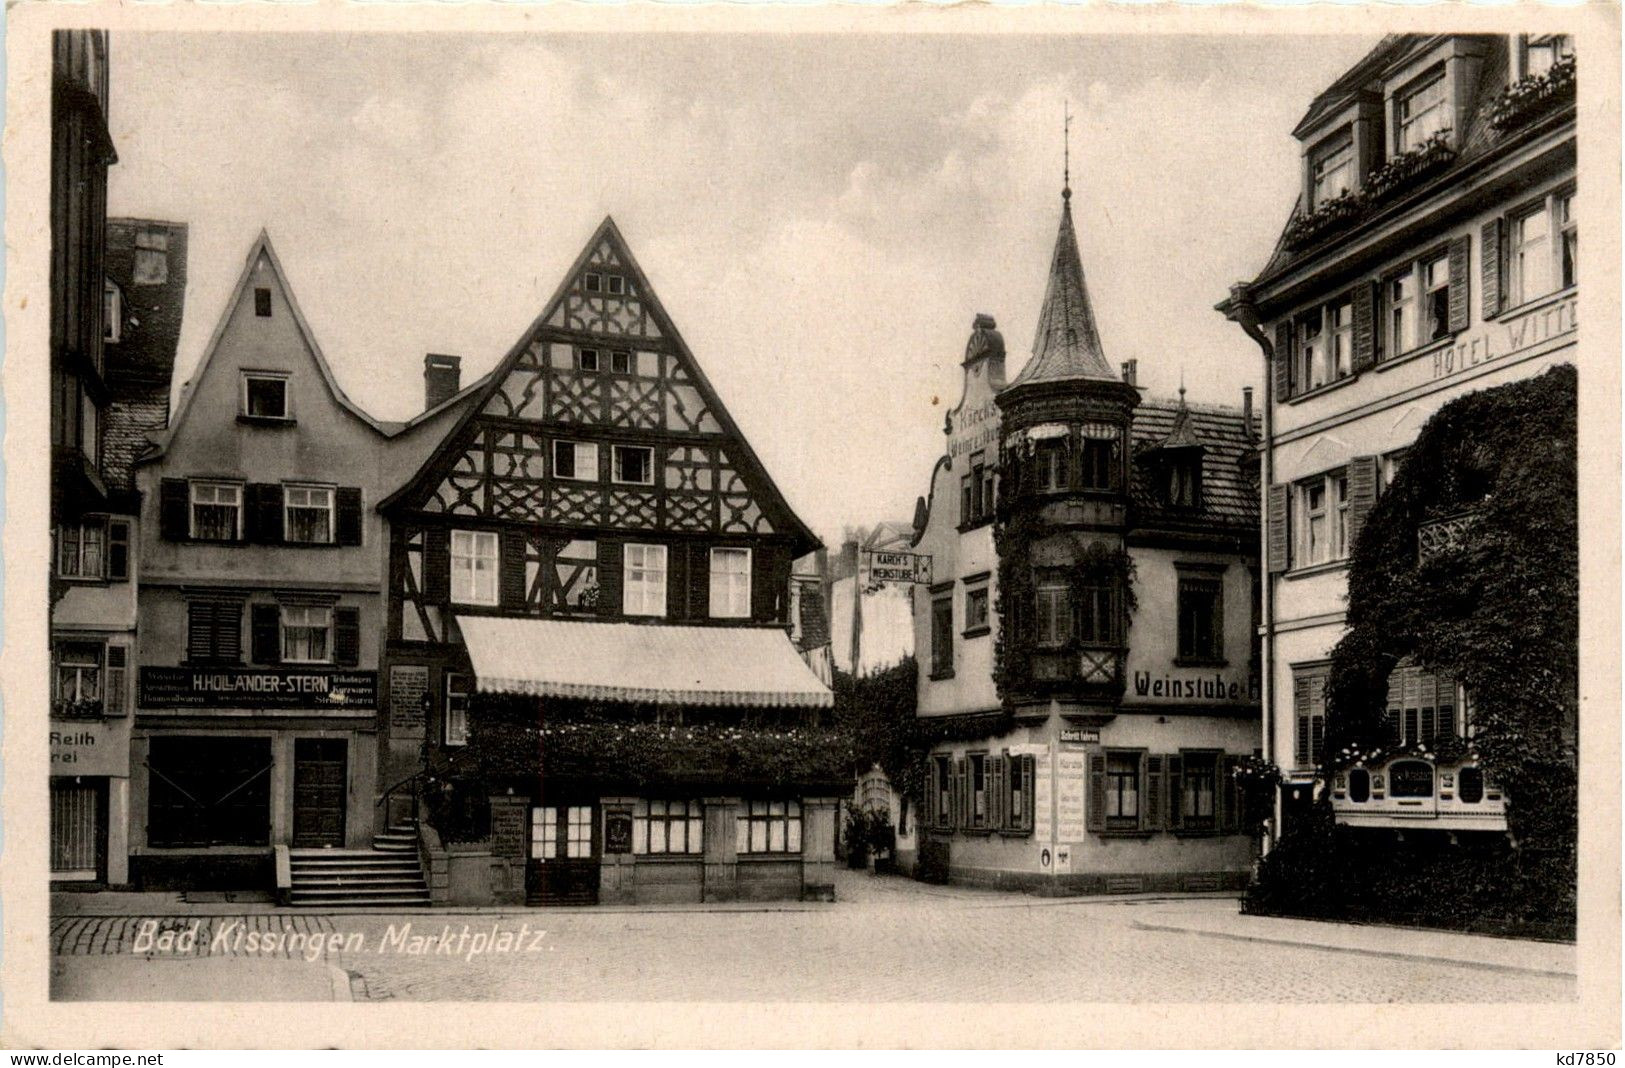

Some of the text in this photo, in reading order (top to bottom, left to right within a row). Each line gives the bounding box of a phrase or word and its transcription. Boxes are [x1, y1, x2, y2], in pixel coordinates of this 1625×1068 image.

[1434, 334, 1494, 379] HOTEL
[873, 567, 913, 580] WEINSTUBE
[49, 731, 95, 746] Reith
[1060, 730, 1079, 741] Schritt
